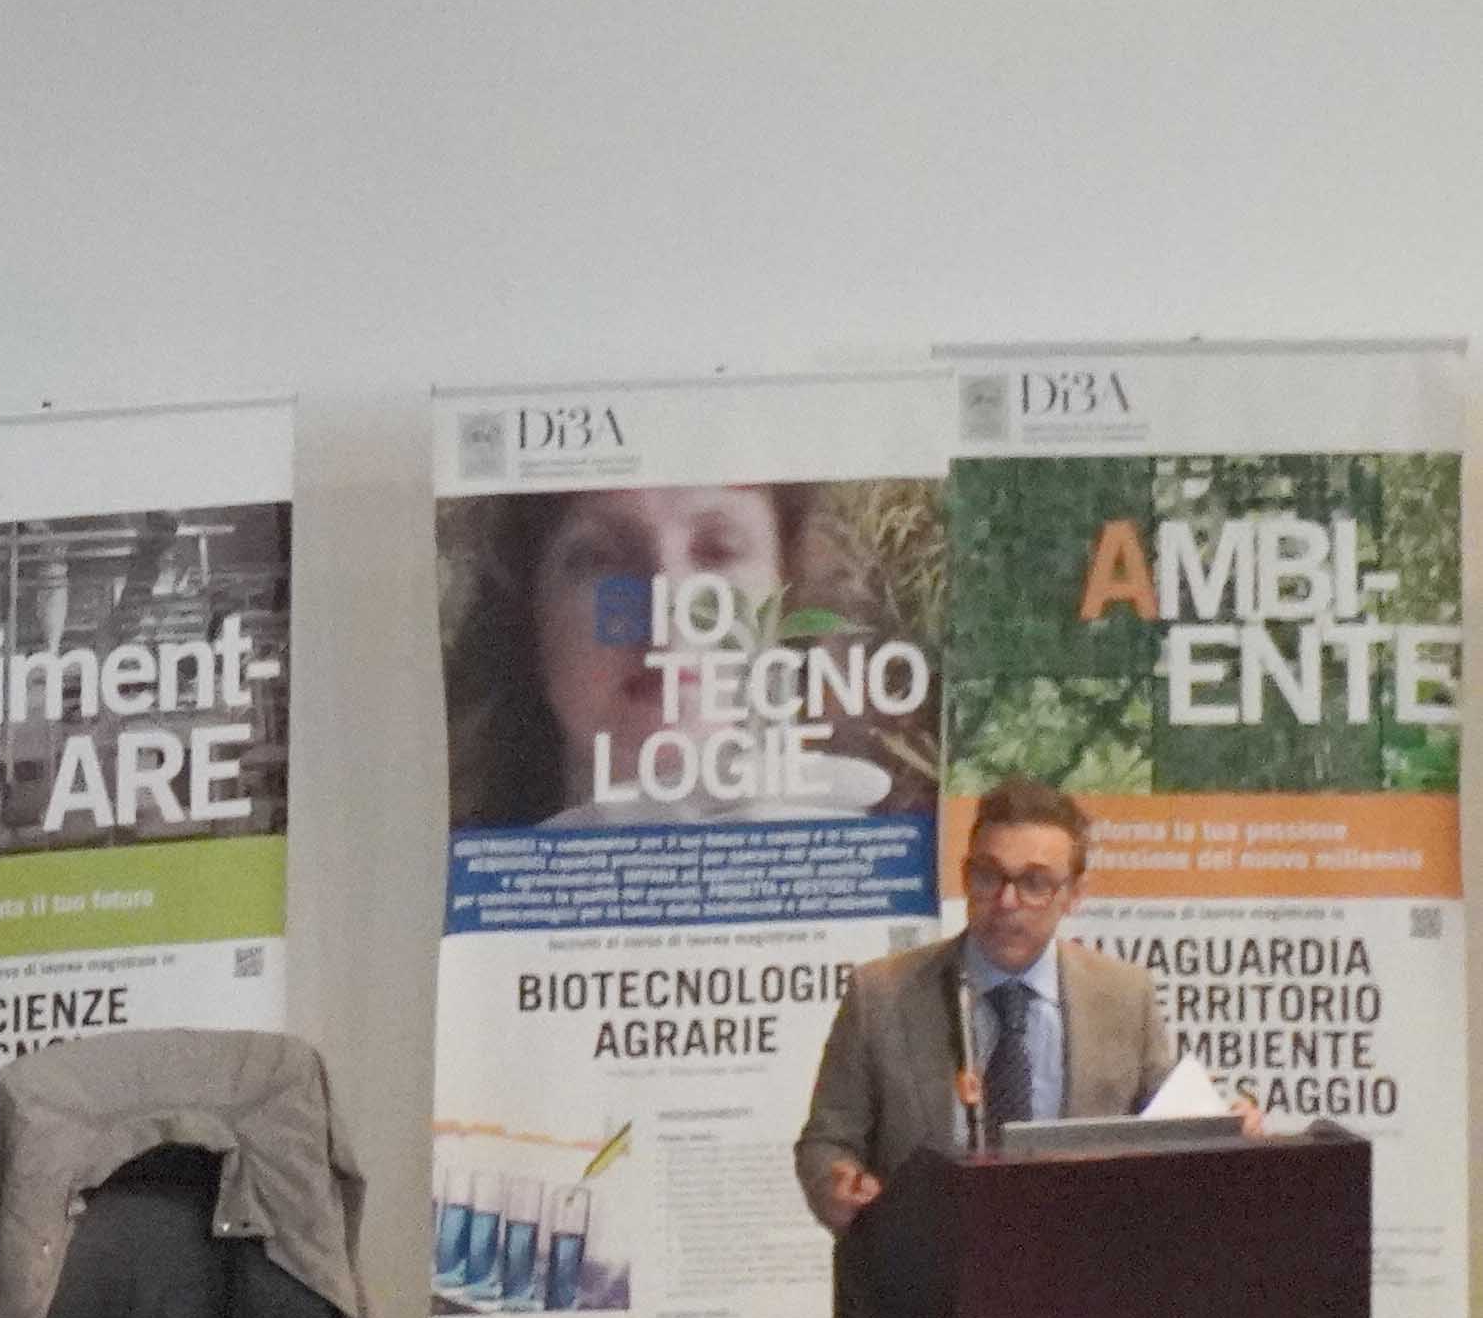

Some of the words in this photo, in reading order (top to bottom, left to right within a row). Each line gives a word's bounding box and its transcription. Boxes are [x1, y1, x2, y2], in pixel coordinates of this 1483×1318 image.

[1021, 370, 1130, 414] Di3A
[519, 406, 624, 451] Di3A
[1079, 510, 1400, 622] AMBI-
[593, 573, 736, 647] BIO
[645, 641, 930, 725] TECNO
[1169, 623, 1462, 726] ENTE
[43, 723, 254, 834] ARE
[593, 723, 835, 804] LOGIE
[52, 894, 85, 914] tuo
[517, 963, 855, 1012] BIOTECNOLOGIE
[594, 1015, 779, 1060] AGRARIE
[1177, 1030, 1376, 1070] MBIENTE
